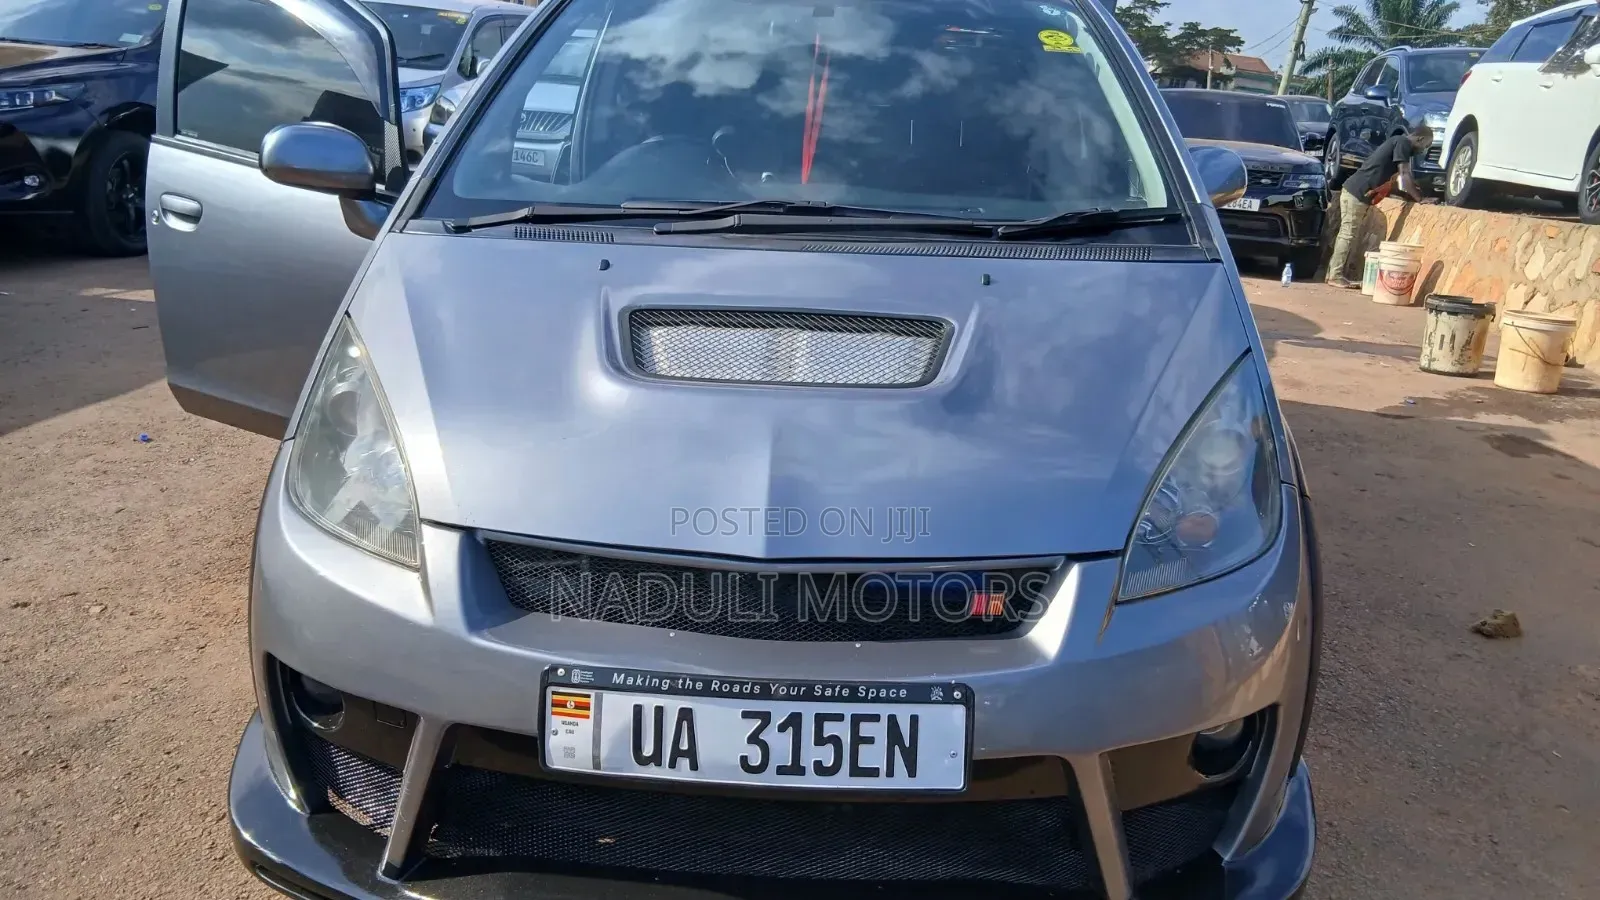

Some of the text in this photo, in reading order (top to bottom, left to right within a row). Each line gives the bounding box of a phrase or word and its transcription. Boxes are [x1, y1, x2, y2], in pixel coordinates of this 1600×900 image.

[612, 672, 908, 699] Making the Roads Your Safe Space
[632, 703, 919, 778] UA 315EN
